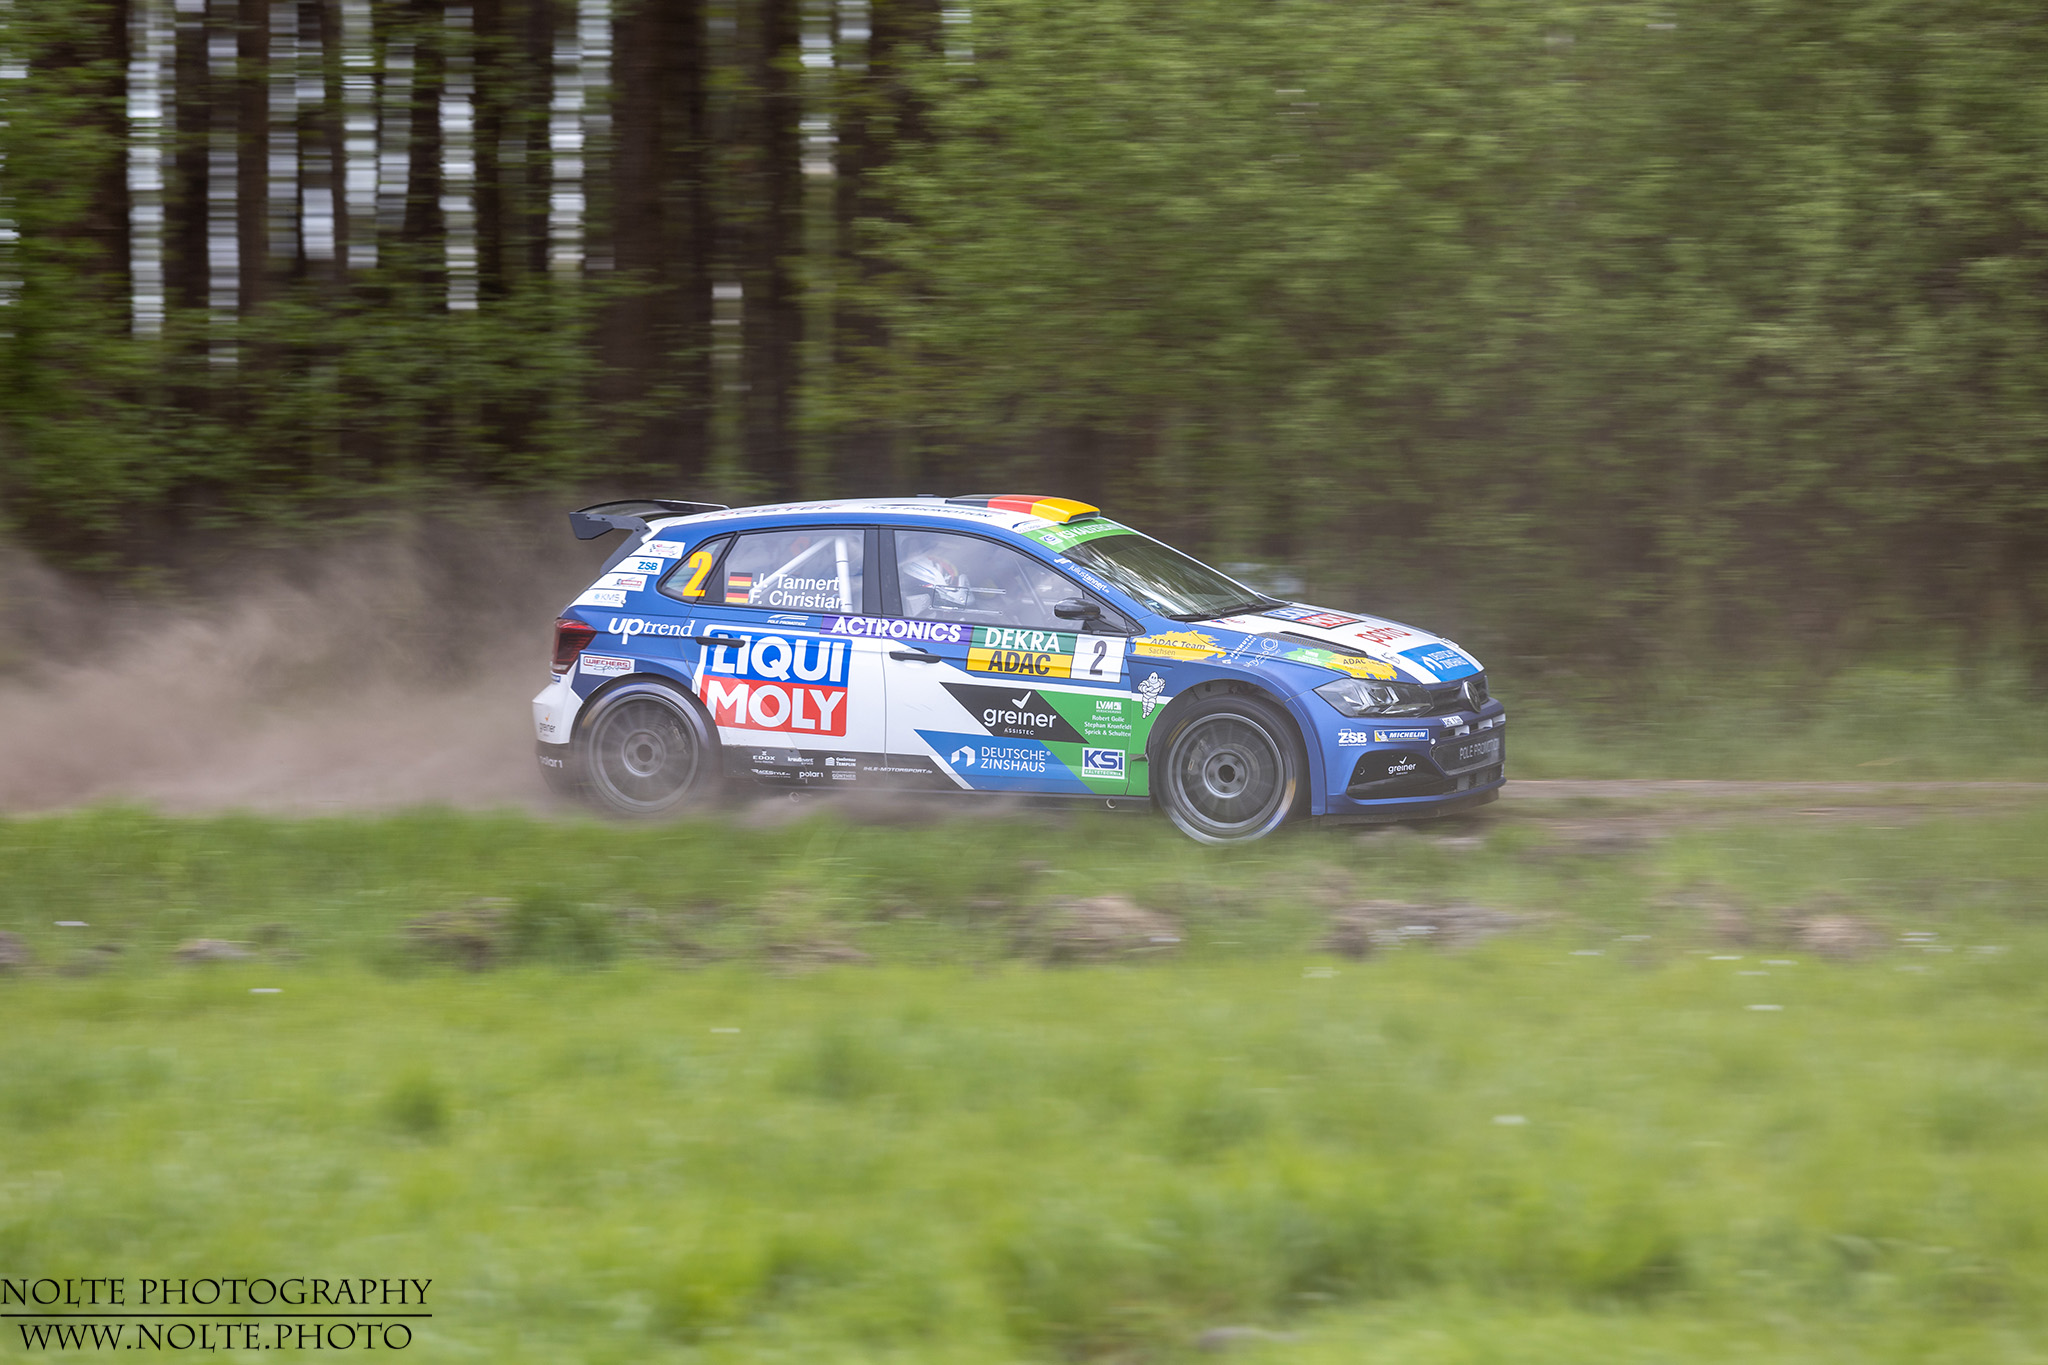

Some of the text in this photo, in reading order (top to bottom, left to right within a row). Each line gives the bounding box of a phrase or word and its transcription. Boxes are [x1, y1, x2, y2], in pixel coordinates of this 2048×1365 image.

[637, 561, 658, 571] ZSB
[682, 551, 713, 597] 2
[752, 573, 840, 591] J. Tannert
[749, 590, 846, 609] F. Christian
[607, 617, 696, 645] uptrend
[831, 616, 962, 643] ACTRONICS
[984, 627, 1061, 653] DEKRA
[1150, 638, 1206, 650] ADAC Team
[711, 633, 846, 682] LIQUI
[1089, 640, 1107, 676] 2
[1148, 647, 1176, 656] Sachsen
[585, 658, 629, 668] WIECHERS
[987, 651, 1051, 675] ADAC
[706, 679, 846, 731] MOLY
[1096, 700, 1114, 710] LVM
[983, 708, 1057, 728] greiner
[1084, 721, 1106, 729] Stephan
[1091, 714, 1110, 722] Robert
[1003, 727, 1035, 736] ASSISTEC
[1084, 728, 1101, 736] Sprick
[1337, 731, 1367, 744] ZSB
[1389, 731, 1426, 739] MICHELIN
[980, 758, 1046, 773] ZINSHAUS
[1388, 763, 1417, 775] greiner
